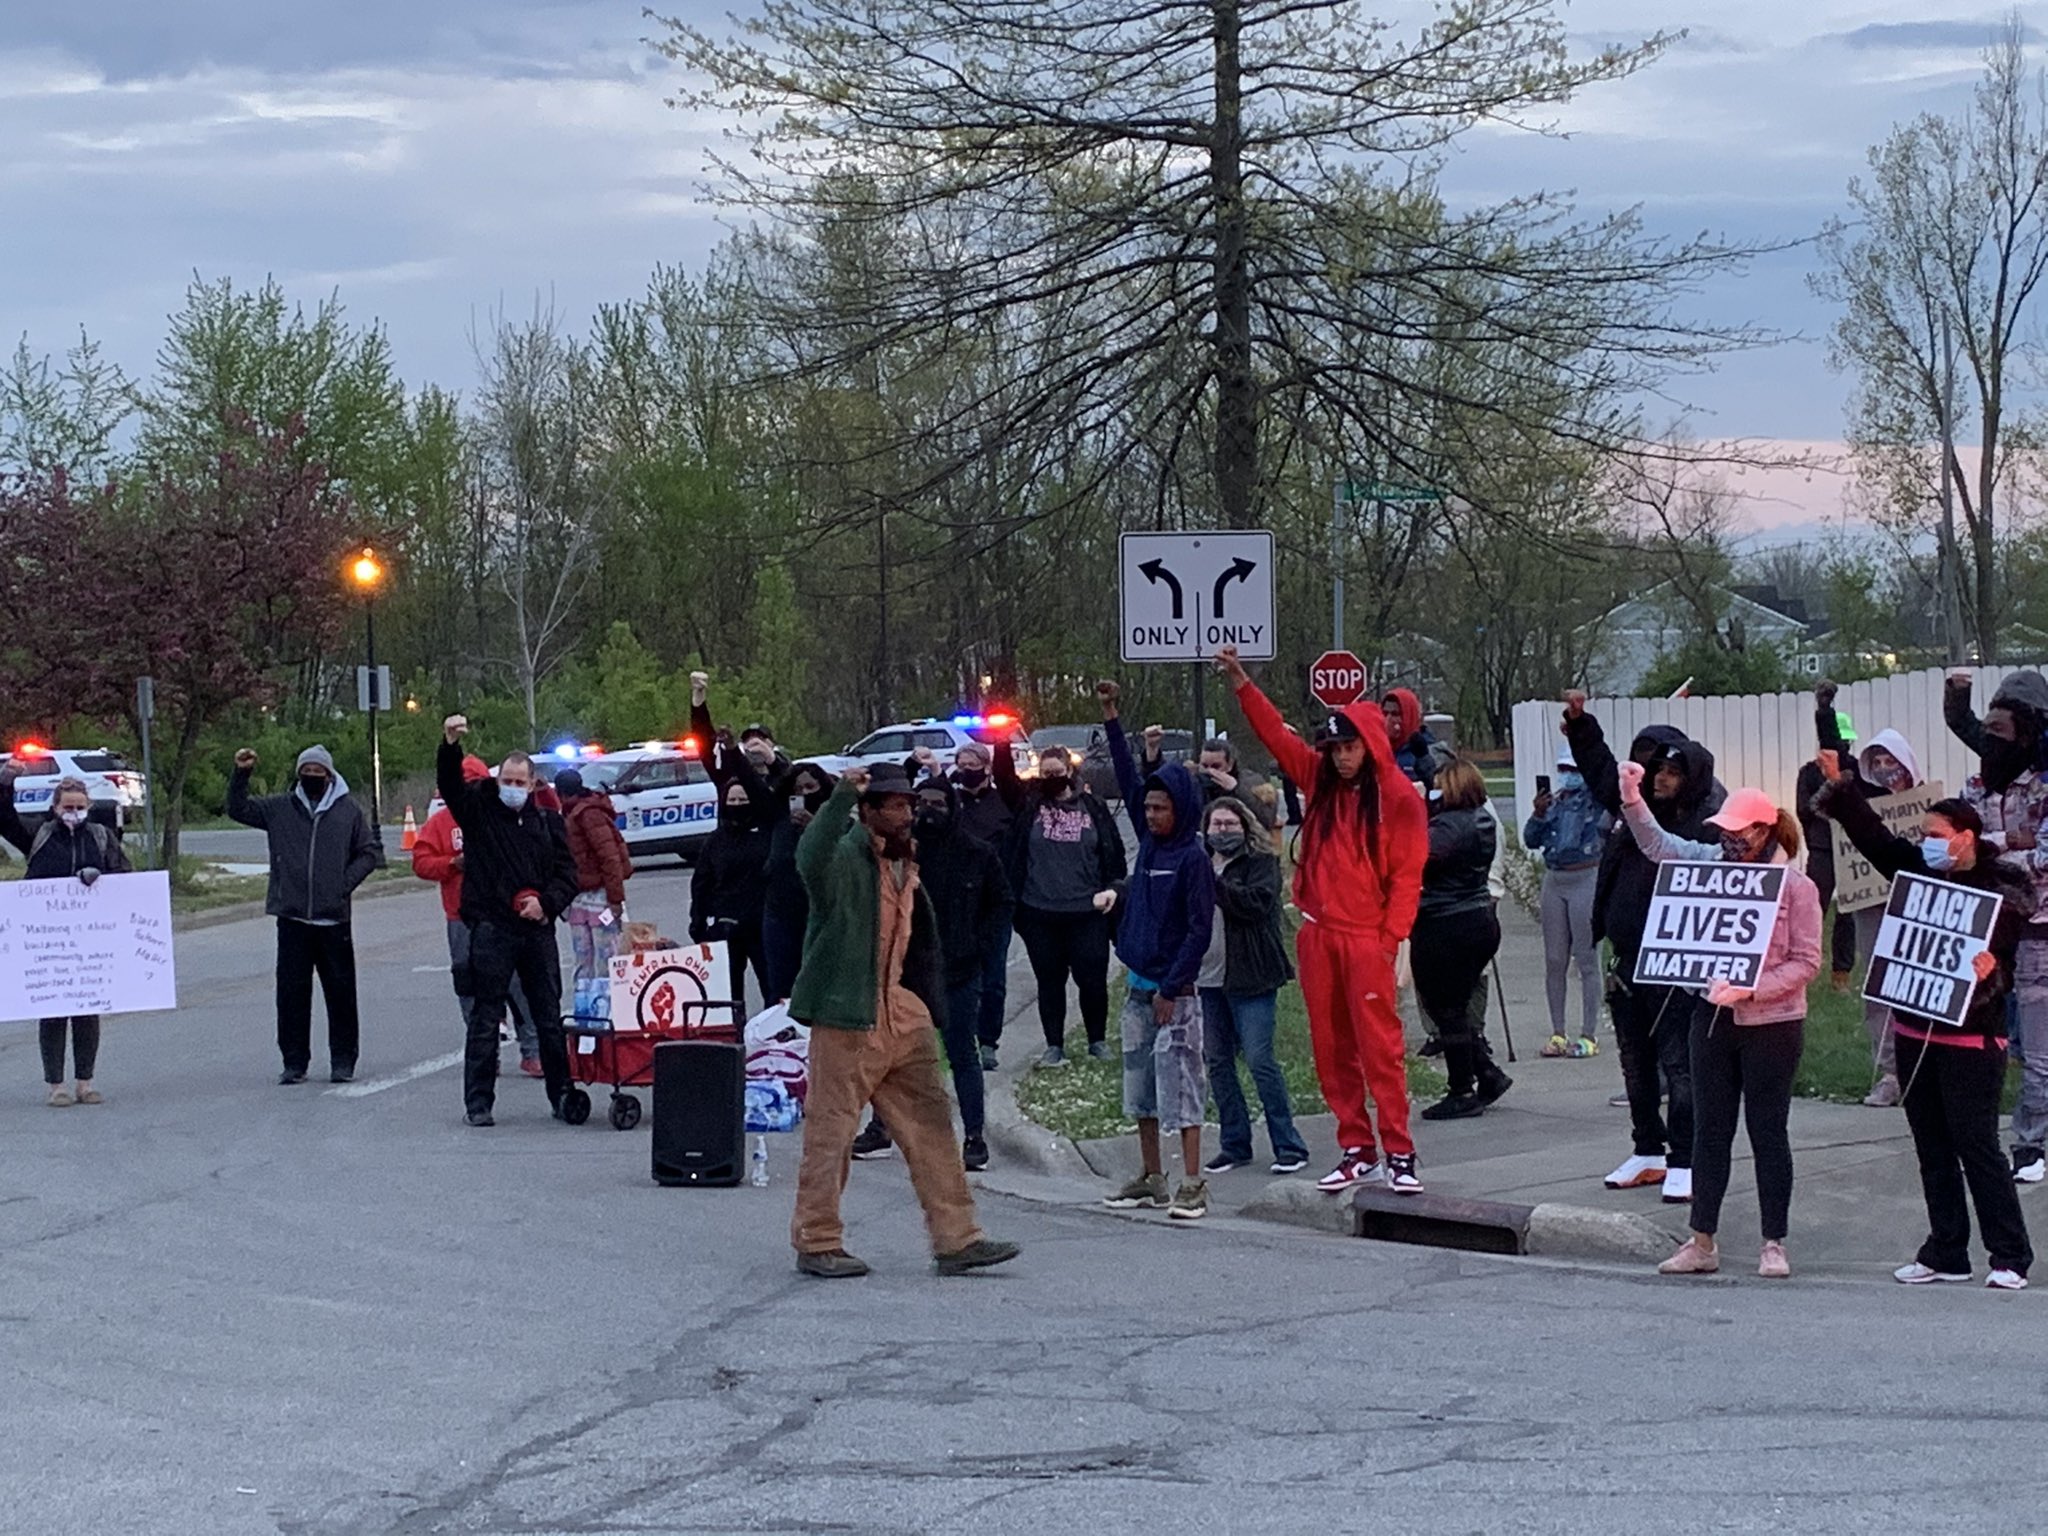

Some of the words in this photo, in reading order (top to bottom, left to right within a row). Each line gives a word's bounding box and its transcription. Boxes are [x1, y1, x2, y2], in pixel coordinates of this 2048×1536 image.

[1132, 626, 1189, 646] ONLY
[1206, 624, 1264, 645] ONLY
[1314, 668, 1363, 690] STOP
[1669, 866, 1768, 897] BLACK
[1848, 860, 1871, 881] to
[18, 883, 58, 898] Black
[46, 899, 90, 912] Matter
[1902, 881, 1981, 934] BLACK
[1656, 904, 1760, 945] LIVES
[1892, 923, 1966, 973] LIVES
[629, 954, 679, 997] CENTRAL
[685, 956, 710, 982] OHIO
[1643, 951, 1751, 982] MATTER
[1880, 961, 1955, 1014] MATTER
